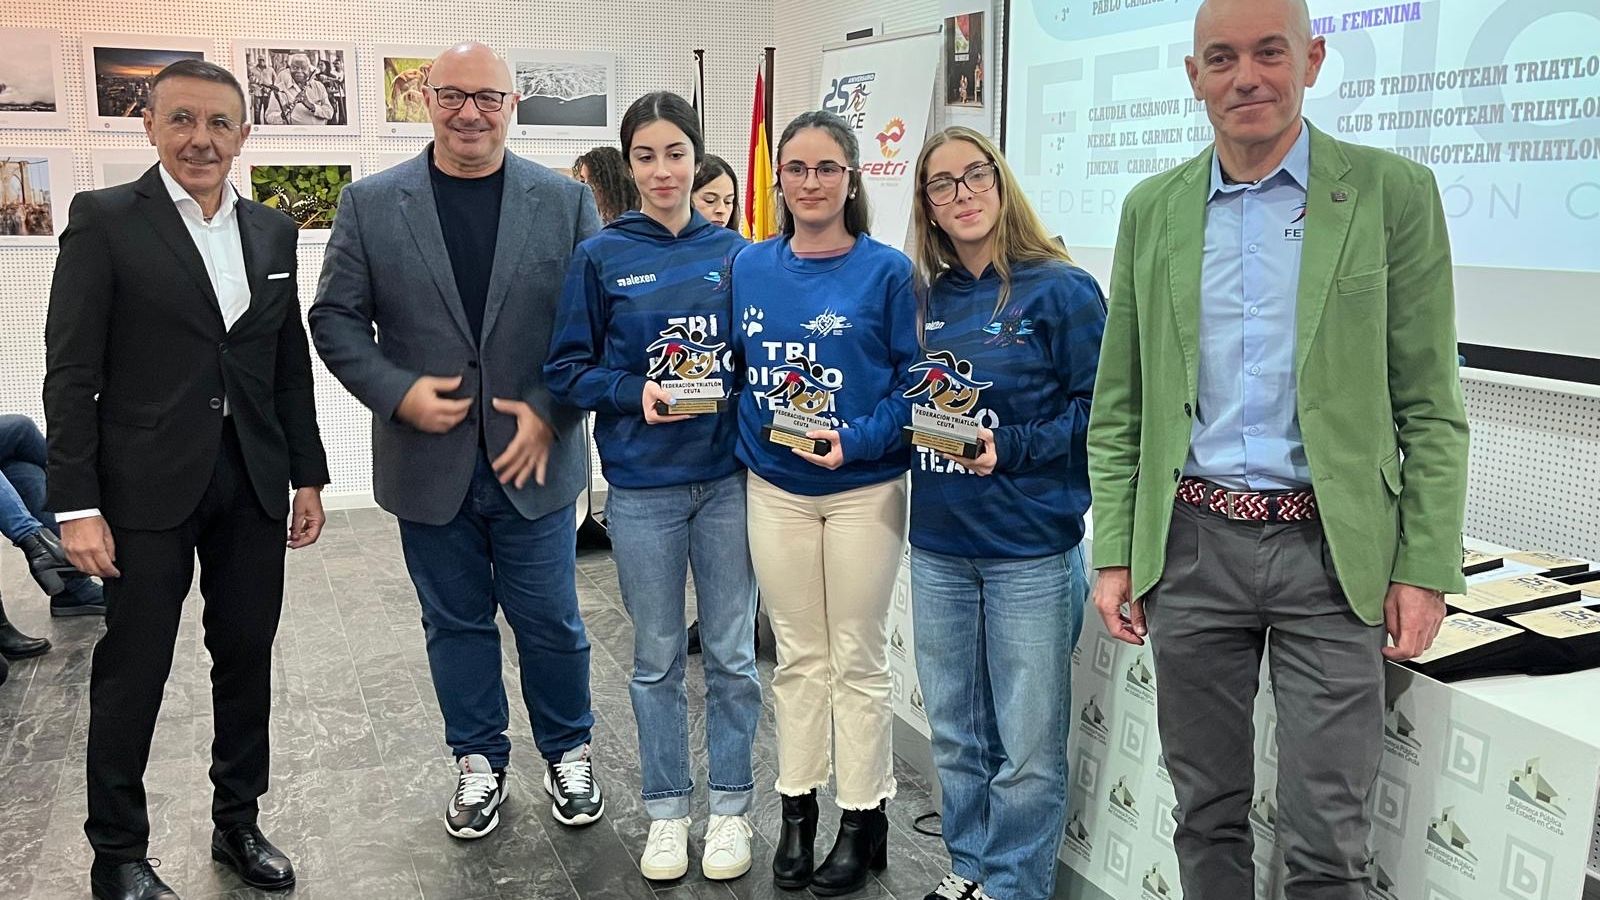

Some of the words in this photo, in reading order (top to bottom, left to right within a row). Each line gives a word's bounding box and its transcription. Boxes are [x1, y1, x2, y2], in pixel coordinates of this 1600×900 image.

[1092, 0, 1121, 16] PABLO
[1311, 16, 1336, 36] NIL
[1341, 2, 1421, 32] FEMENINA
[1339, 78, 1375, 99] CLUB
[1380, 64, 1508, 95] TRIDINGOTEAM
[1088, 104, 1127, 122] CLAUDIA
[1130, 99, 1179, 119] CASANOVA
[1337, 114, 1373, 133] CLUB
[1378, 103, 1504, 131] TRIDINGOTEAM
[1087, 133, 1116, 149] NEREA
[1119, 131, 1138, 147] DEL
[1142, 128, 1183, 146] CARMEN
[1086, 160, 1120, 180] JIMENA
[626, 273, 657, 286] alexen
[762, 341, 817, 362] TRI
[793, 420, 809, 428] CEUTA
[936, 421, 955, 429] CEUTA
[1505, 803, 1515, 812] del
[1515, 807, 1536, 823] Estado
[1536, 819, 1545, 827] en
[1545, 822, 1564, 836] Ceuta
[1509, 797, 1539, 816] Biblioteca
[1539, 811, 1562, 828] Pública
